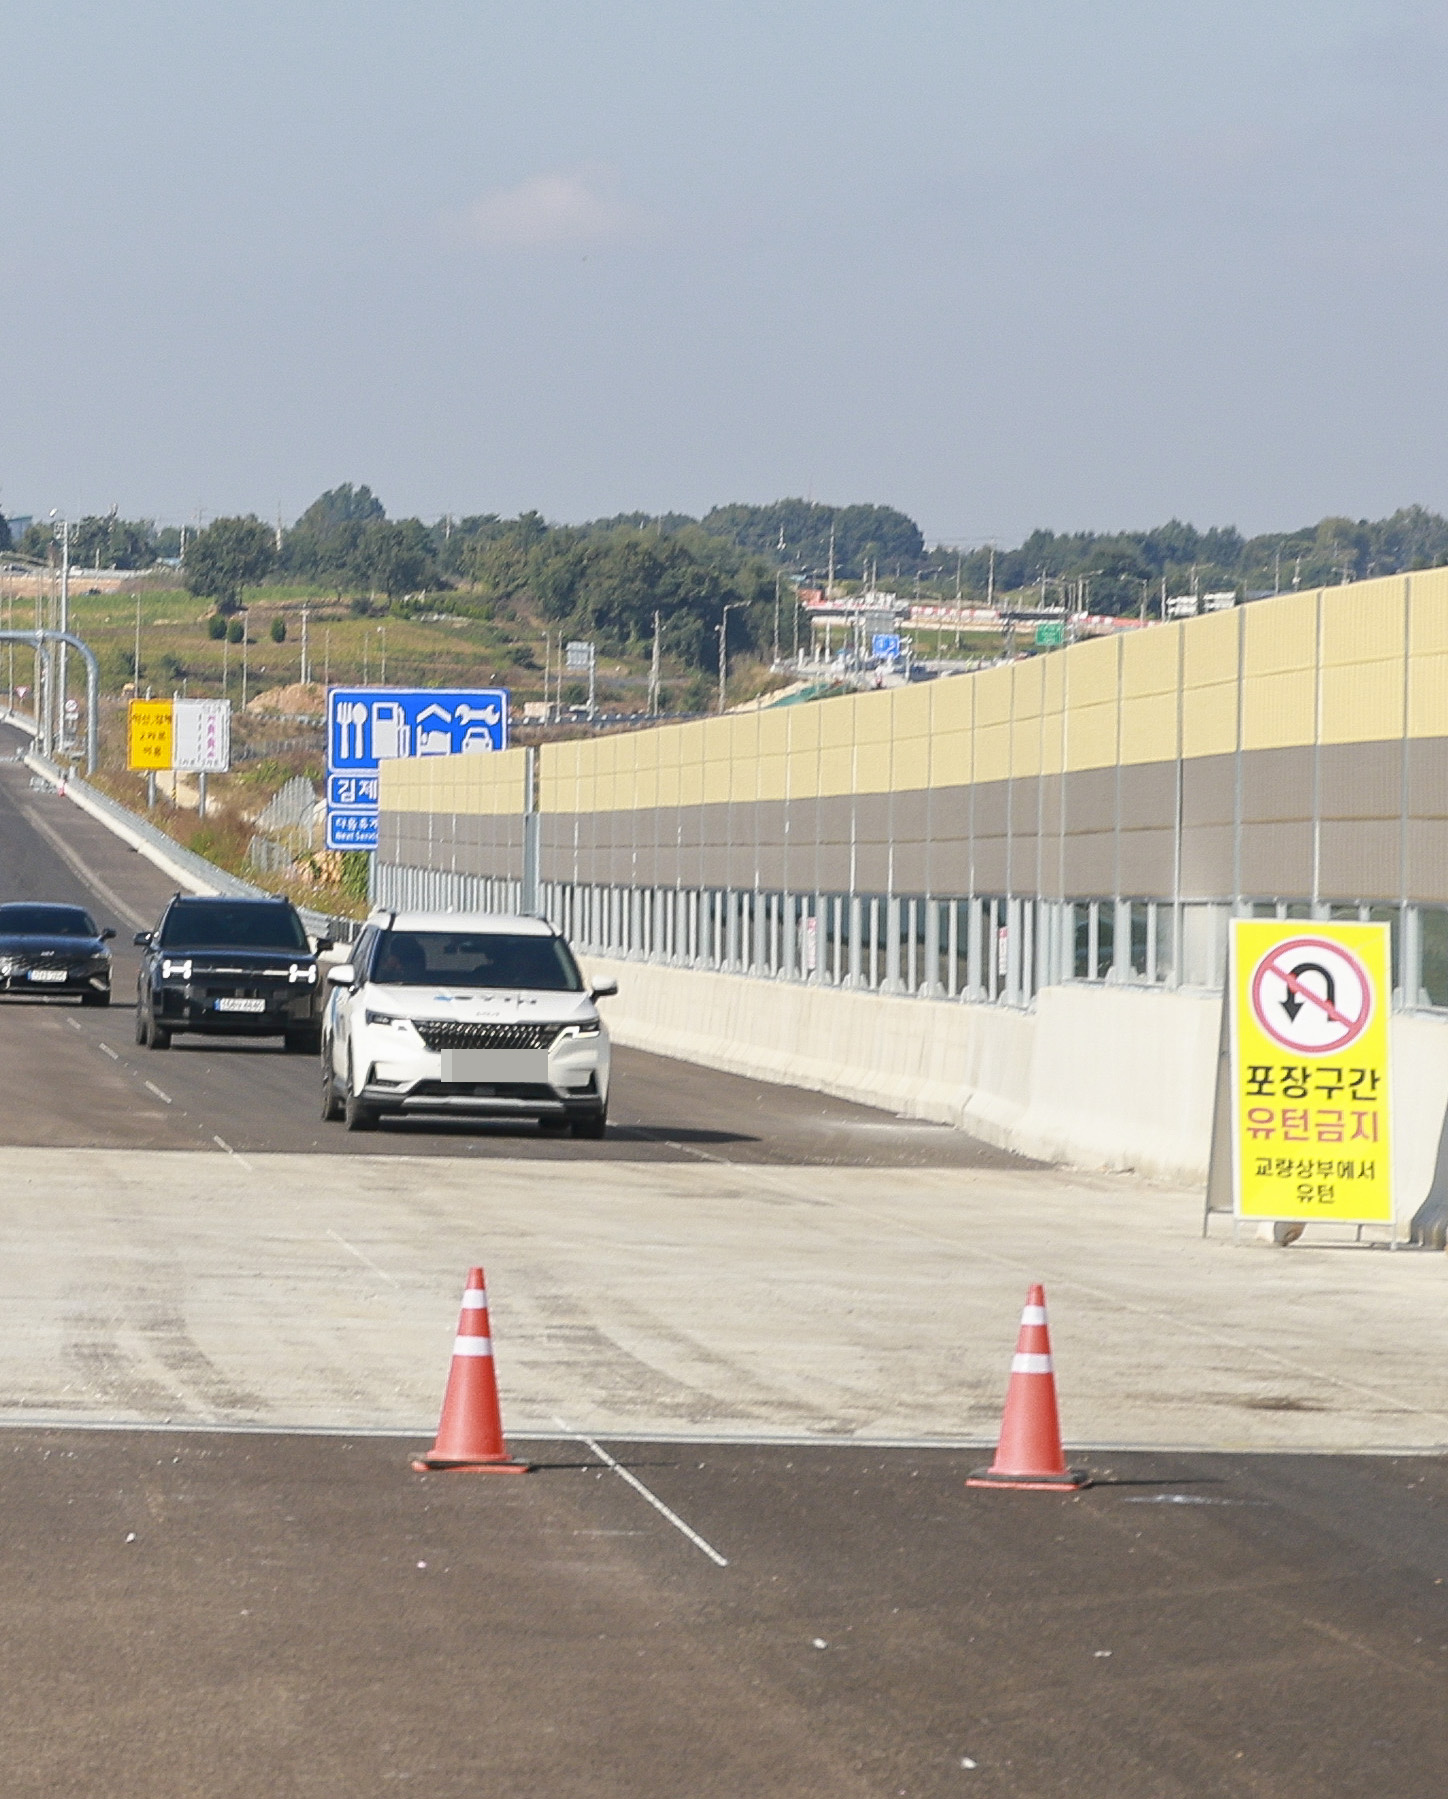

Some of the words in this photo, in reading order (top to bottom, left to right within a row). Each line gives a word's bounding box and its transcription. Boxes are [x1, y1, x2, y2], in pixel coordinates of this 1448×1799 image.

[337, 779, 378, 802] 김제
[1245, 1065, 1381, 1101] 포장구간
[1246, 1107, 1379, 1143] 유턴금지
[1255, 1157, 1376, 1180] 교량상부에서
[1296, 1184, 1335, 1204] 유턴
